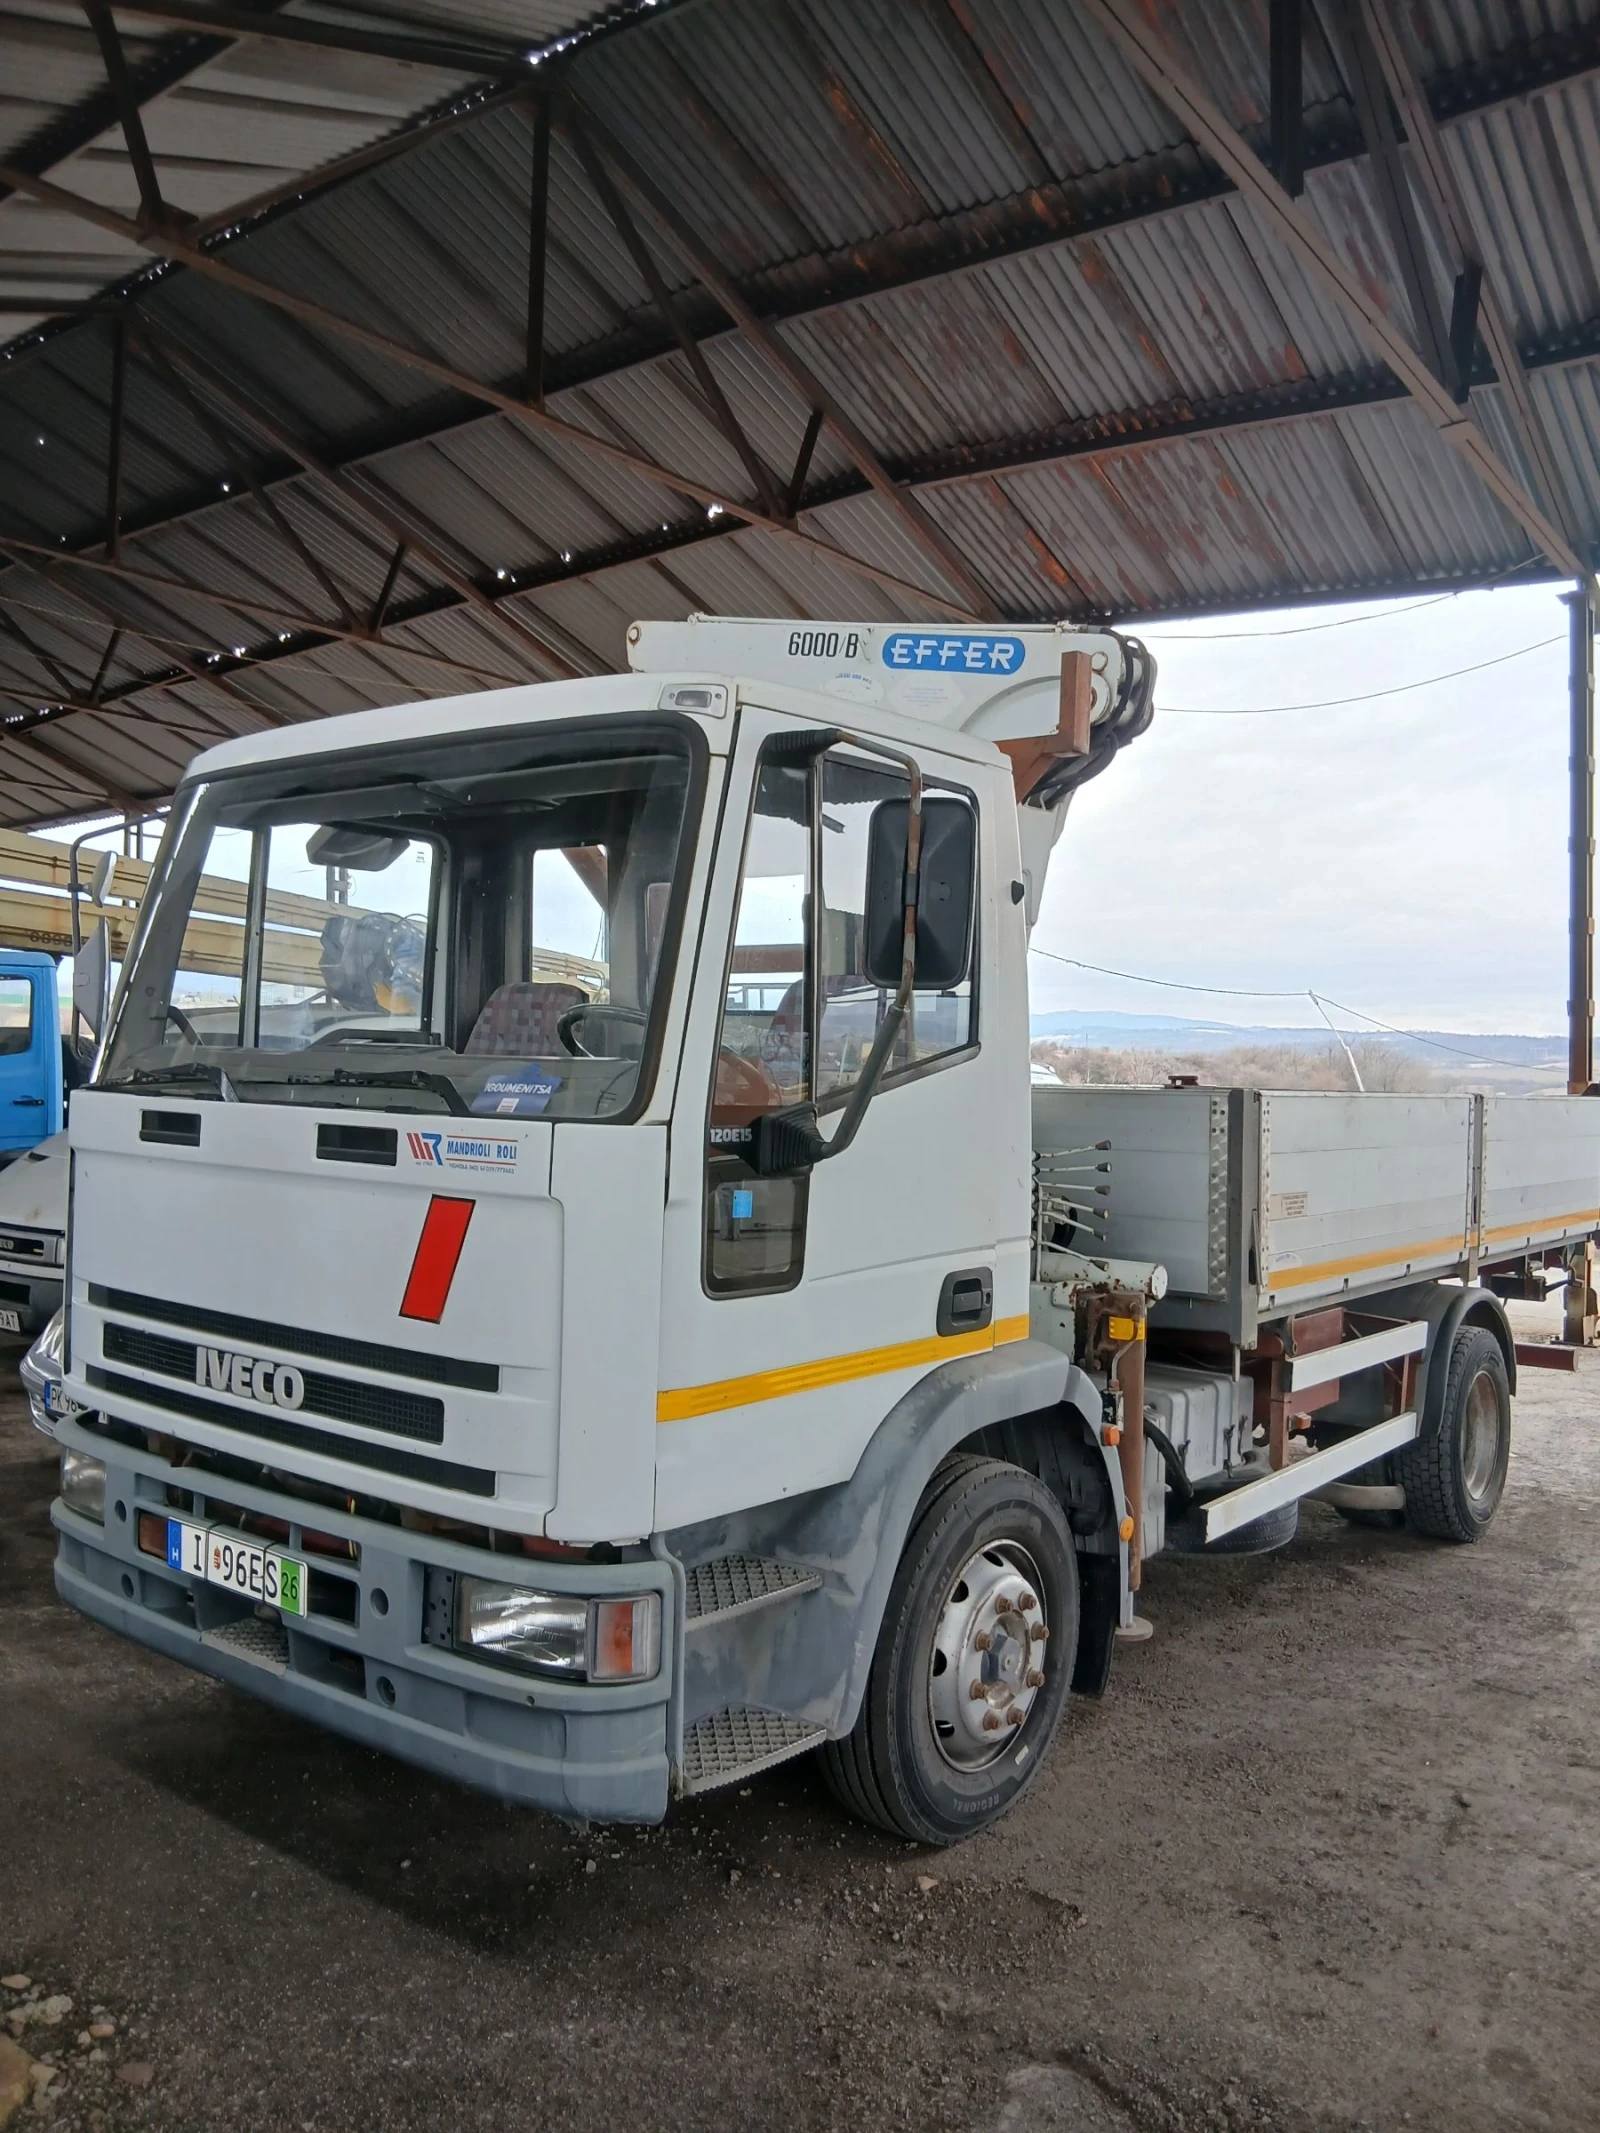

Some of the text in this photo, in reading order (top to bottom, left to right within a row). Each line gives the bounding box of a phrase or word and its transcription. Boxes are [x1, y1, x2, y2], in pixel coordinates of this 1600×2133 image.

[788, 632, 859, 658] 6000/B
[890, 638, 1015, 669] EFFER
[484, 1083, 552, 1095] IGOUMENITSA
[710, 1128, 752, 1142] 120E15
[447, 1141, 517, 1160] MANDRIOLI ROLI
[196, 1346, 304, 1410] IVECO
[172, 1547, 179, 1561] H
[222, 1544, 278, 1599] 96ES
[281, 1571, 298, 1600] 26
